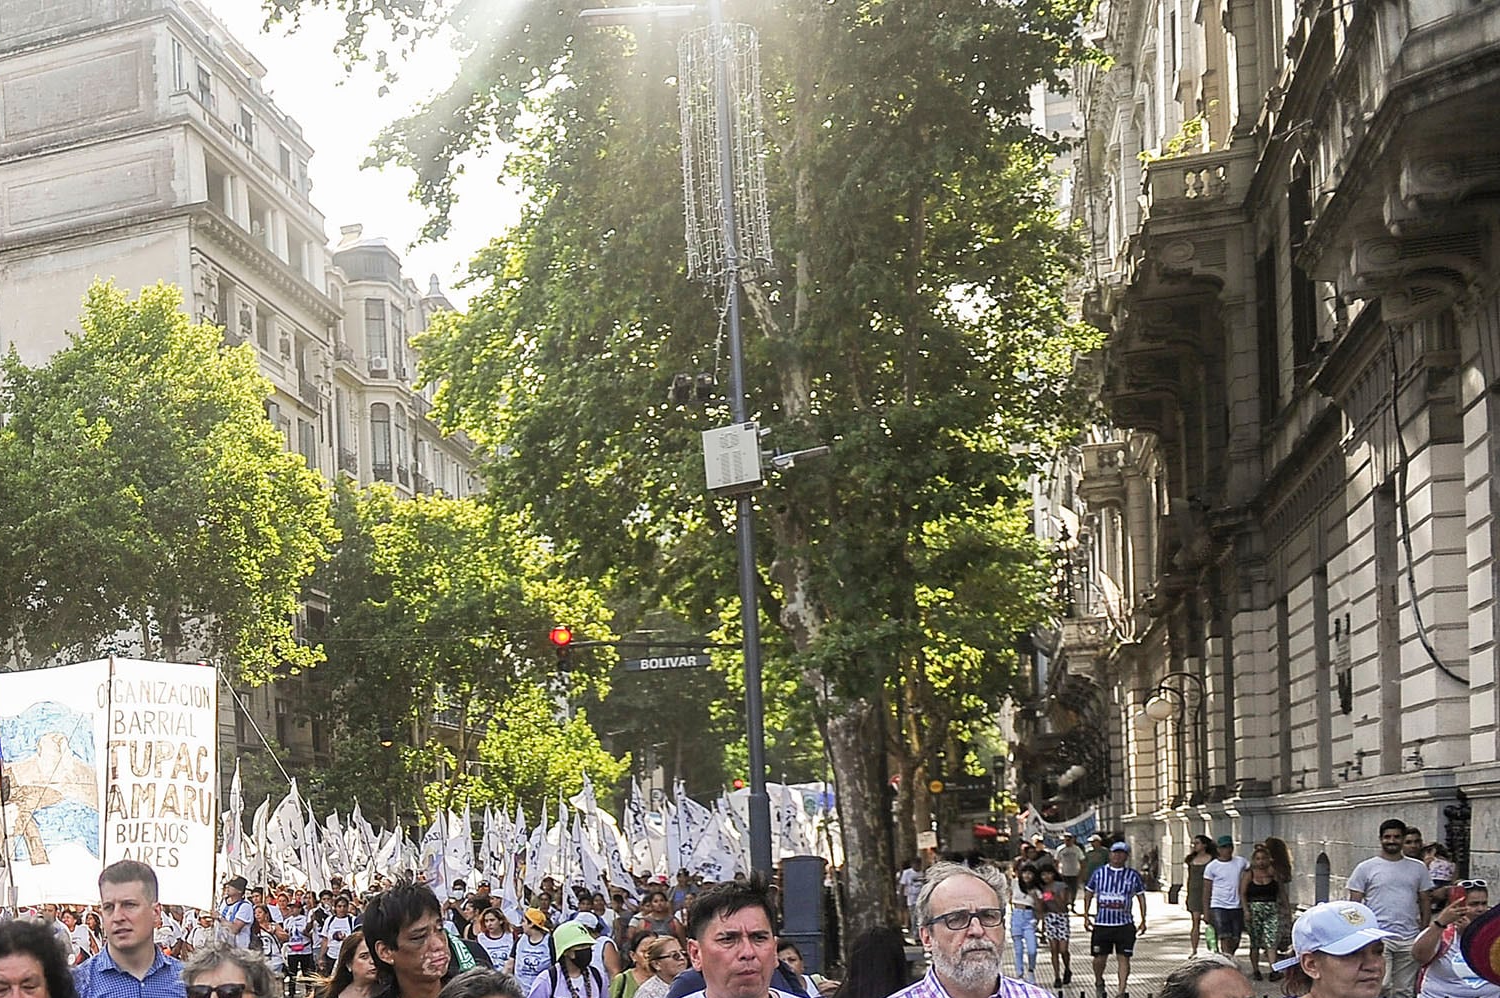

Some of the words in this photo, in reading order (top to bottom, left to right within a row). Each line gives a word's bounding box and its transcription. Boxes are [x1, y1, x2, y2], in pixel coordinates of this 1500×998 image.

[640, 655, 697, 670] BOLIVAR
[114, 710, 197, 737] BARRIAL
[107, 740, 209, 783] TUPAC
[107, 783, 212, 826] AMARU
[116, 822, 189, 844] BUENOS
